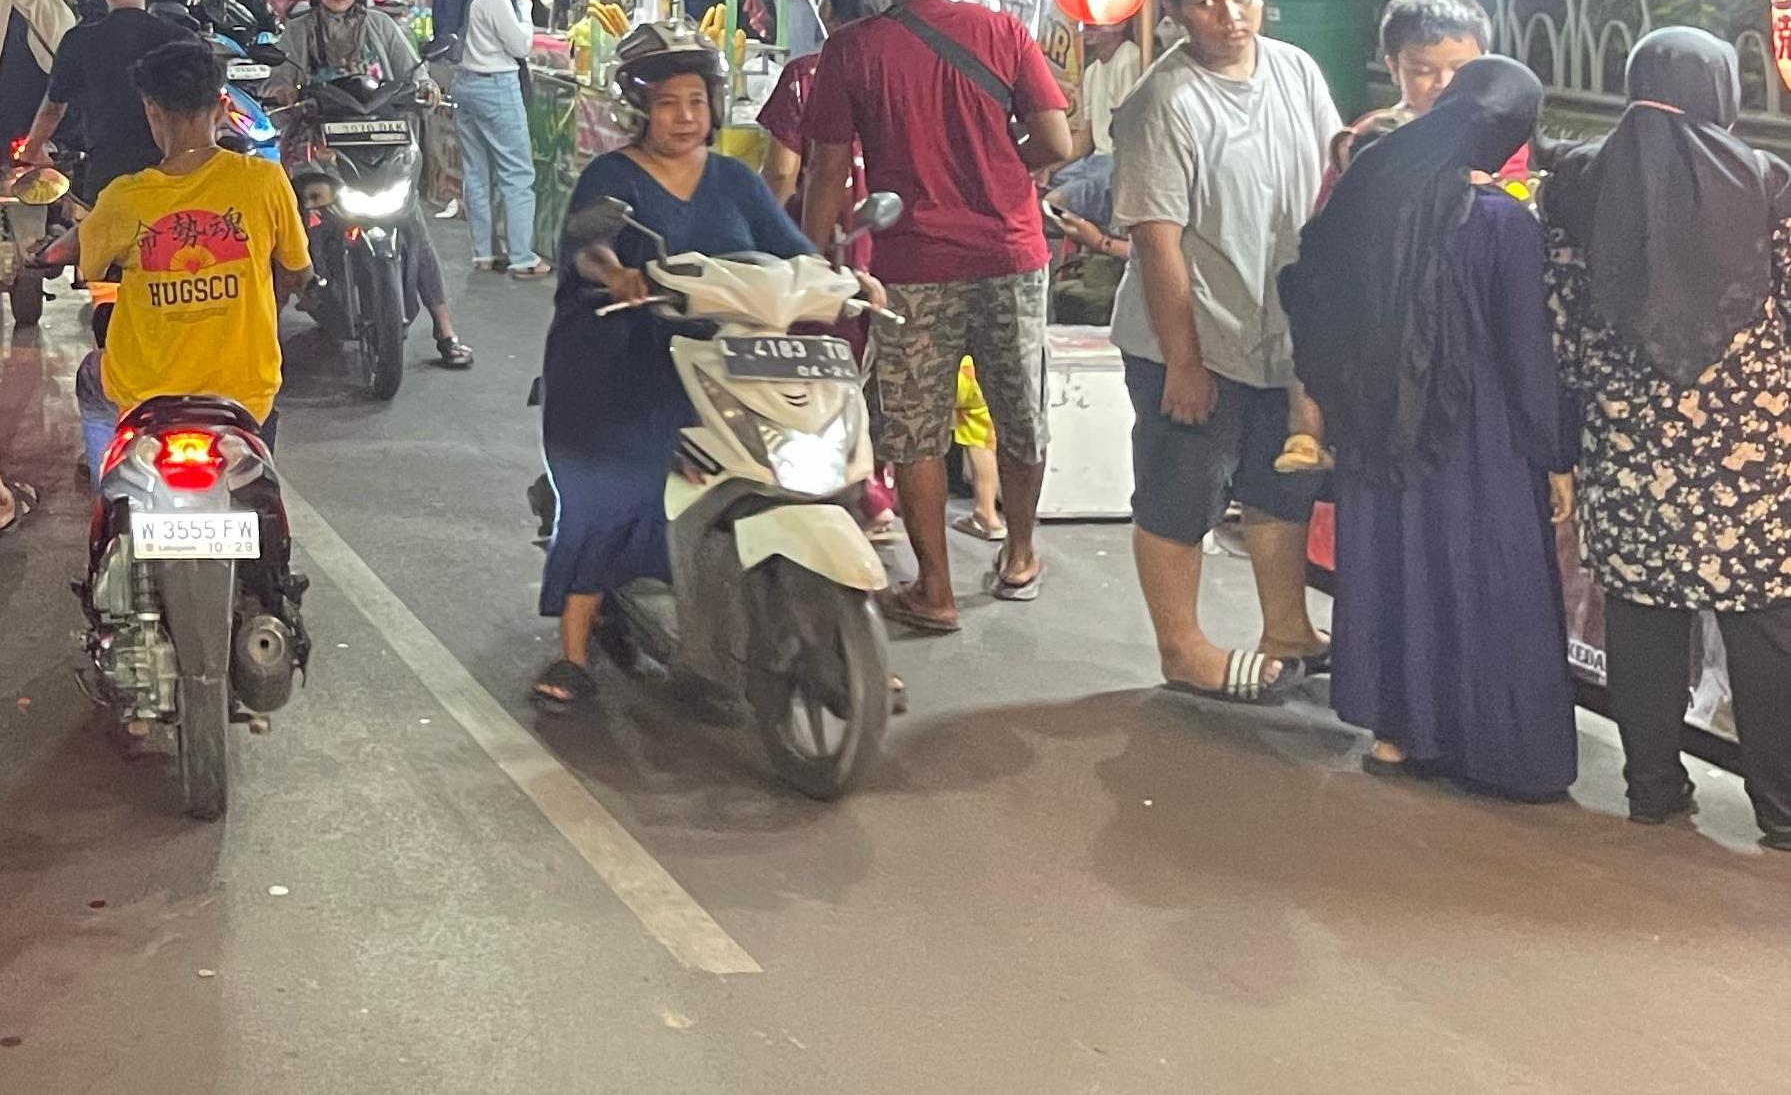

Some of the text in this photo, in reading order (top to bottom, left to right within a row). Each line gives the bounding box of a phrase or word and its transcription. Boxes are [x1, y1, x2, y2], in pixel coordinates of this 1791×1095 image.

[148, 274, 239, 307] HUGSCO
[141, 521, 155, 540] W
[163, 520, 216, 540] 3555
